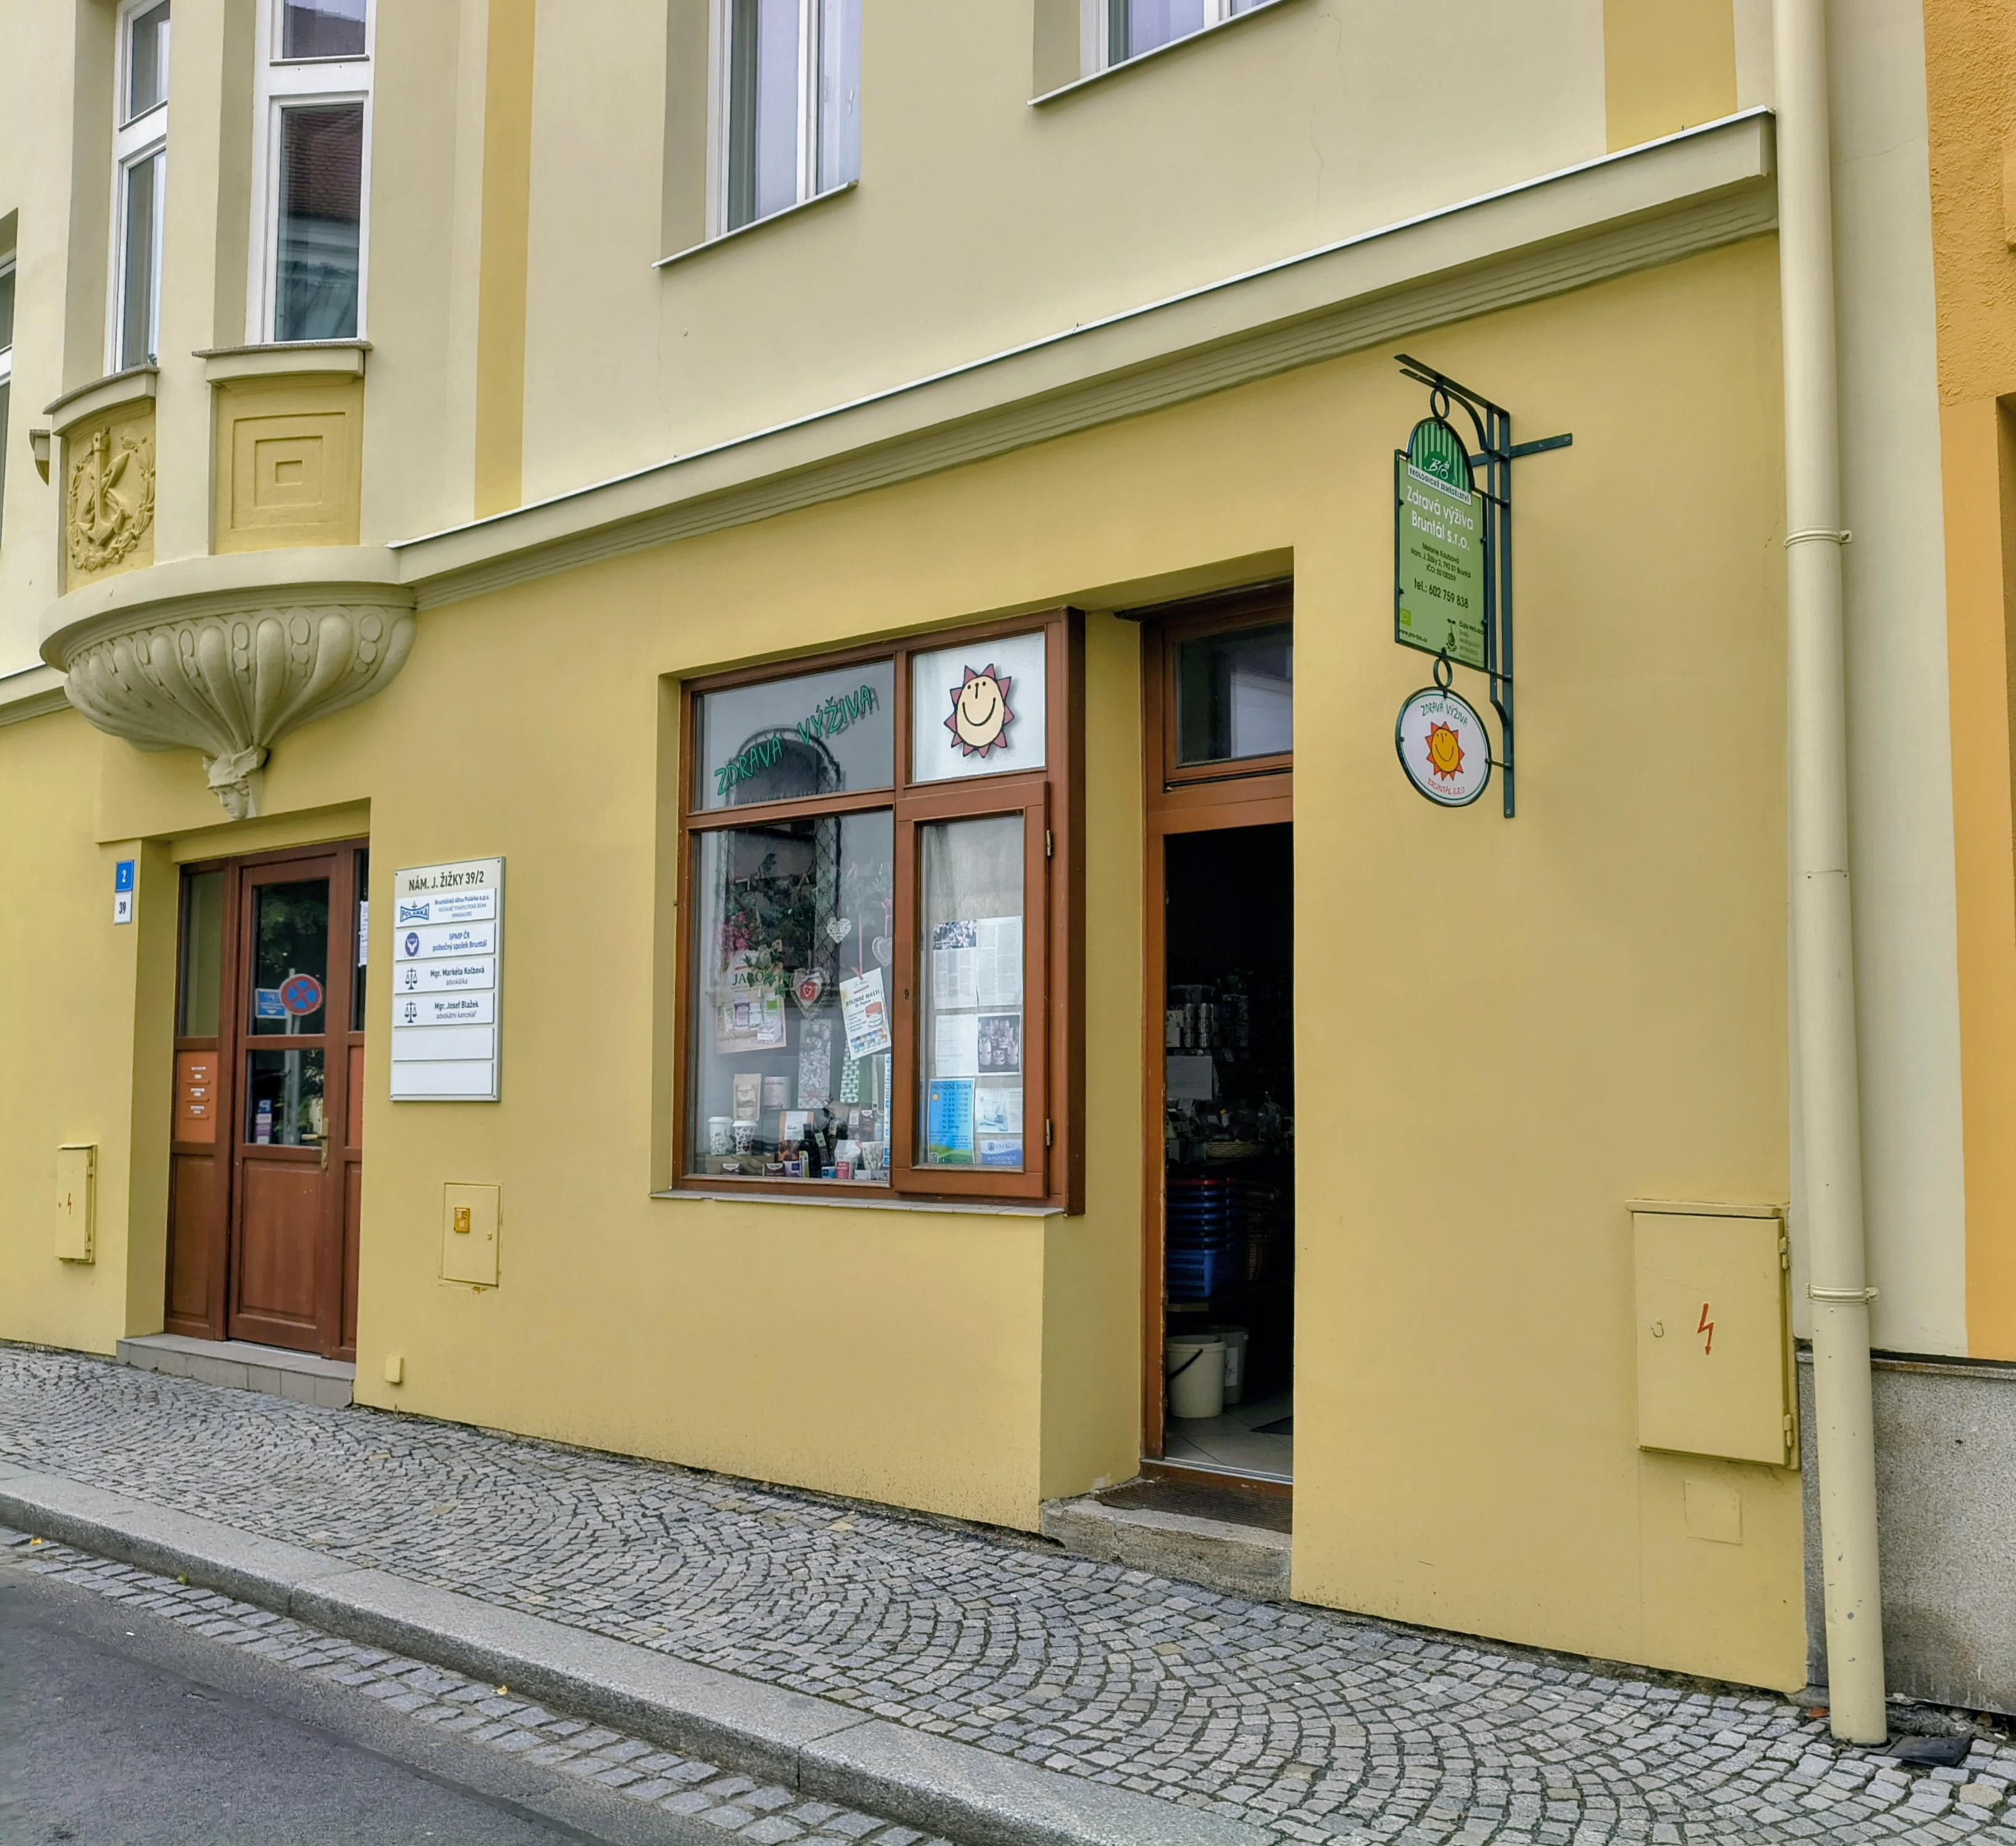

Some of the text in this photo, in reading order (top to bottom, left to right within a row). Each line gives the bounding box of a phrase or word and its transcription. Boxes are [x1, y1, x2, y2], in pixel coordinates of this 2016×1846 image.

[1407, 485, 1473, 530] Zdravá výživa
[1412, 509, 1470, 551] Bruntál s.r.o.
[1414, 577, 1469, 609] tel.: 602 759 838
[1420, 700, 1468, 727] ZDRAVÁ VÝŽIVA
[714, 685, 872, 796] ZDRAVÁ VÝŽIVA
[122, 869, 127, 883] 2
[408, 870, 484, 891] NÁM. J. ŽIŽKY 39/2
[119, 901, 127, 914] 39
[463, 930, 470, 939] ČR
[432, 939, 487, 953] pobočný spolek Bruntál
[430, 970, 441, 979] Mgr.
[442, 967, 463, 976] Markéta
[434, 999, 479, 1012] Mgr. Josef Blažek
